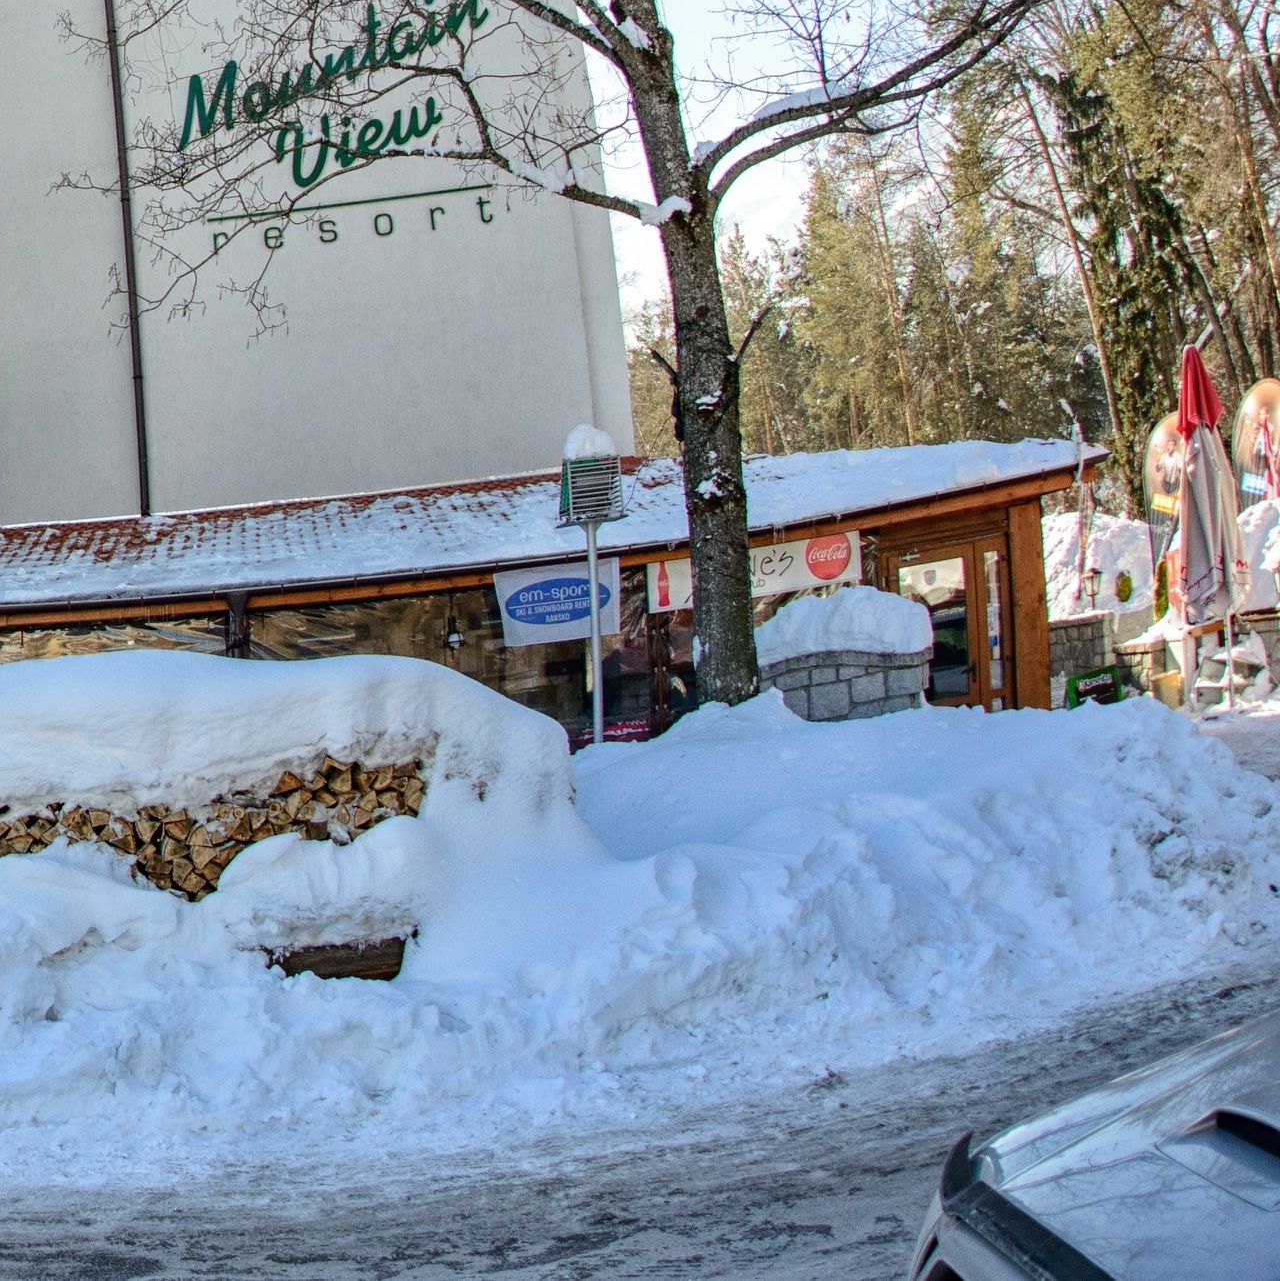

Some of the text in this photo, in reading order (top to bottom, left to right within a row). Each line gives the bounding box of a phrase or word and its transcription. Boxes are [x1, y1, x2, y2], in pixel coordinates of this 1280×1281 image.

[276, 95, 444, 189] View
[211, 195, 495, 256] resort
[807, 542, 849, 565] Coca-Cola
[519, 583, 591, 604] em-spor
[515, 607, 526, 617] SKI
[527, 606, 533, 616] &
[534, 601, 574, 615] SNOWBOARD
[545, 613, 570, 623] BANSKO
